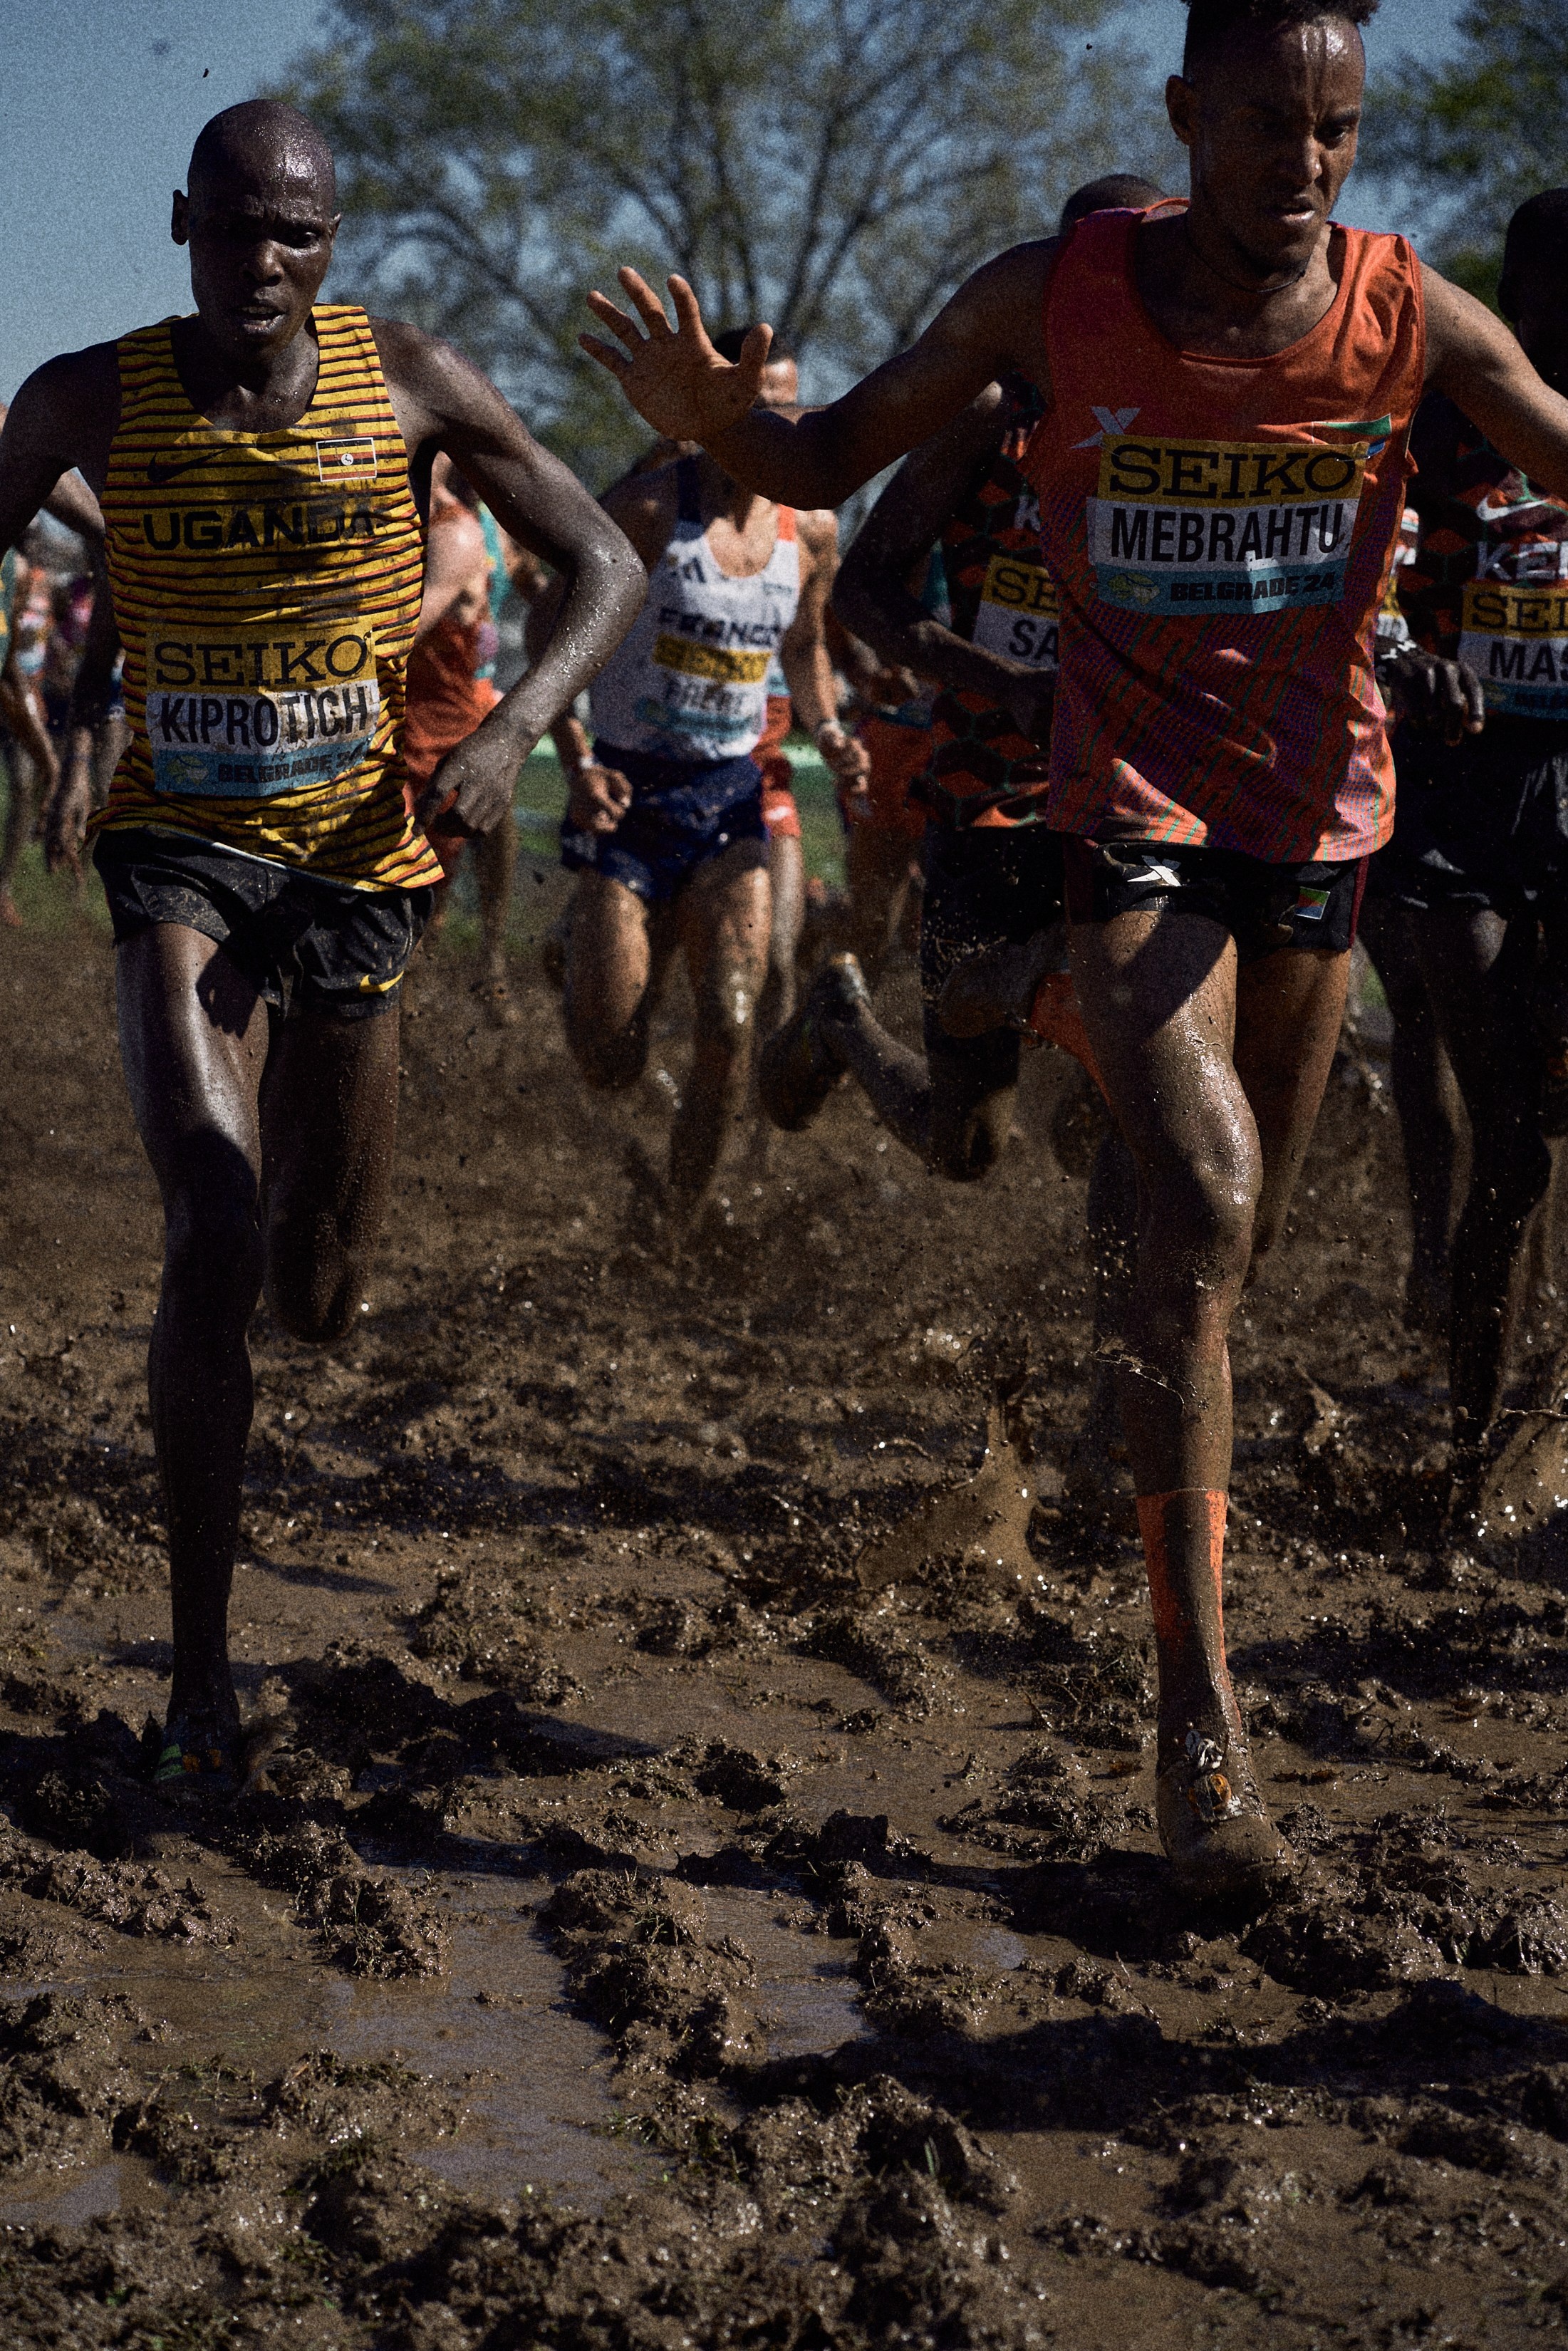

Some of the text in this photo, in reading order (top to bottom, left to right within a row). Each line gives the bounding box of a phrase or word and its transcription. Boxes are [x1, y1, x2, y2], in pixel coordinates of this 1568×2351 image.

[1110, 444, 1356, 499] SEIKO
[1111, 503, 1344, 562] MEBRAHTU
[1475, 540, 1568, 581] KE
[1170, 571, 1336, 601] BELGRADE 24
[155, 634, 368, 686] SEIKO
[1009, 618, 1060, 664] SA
[161, 685, 368, 747] KIPROTICH
[218, 754, 333, 784] BELGRADE
